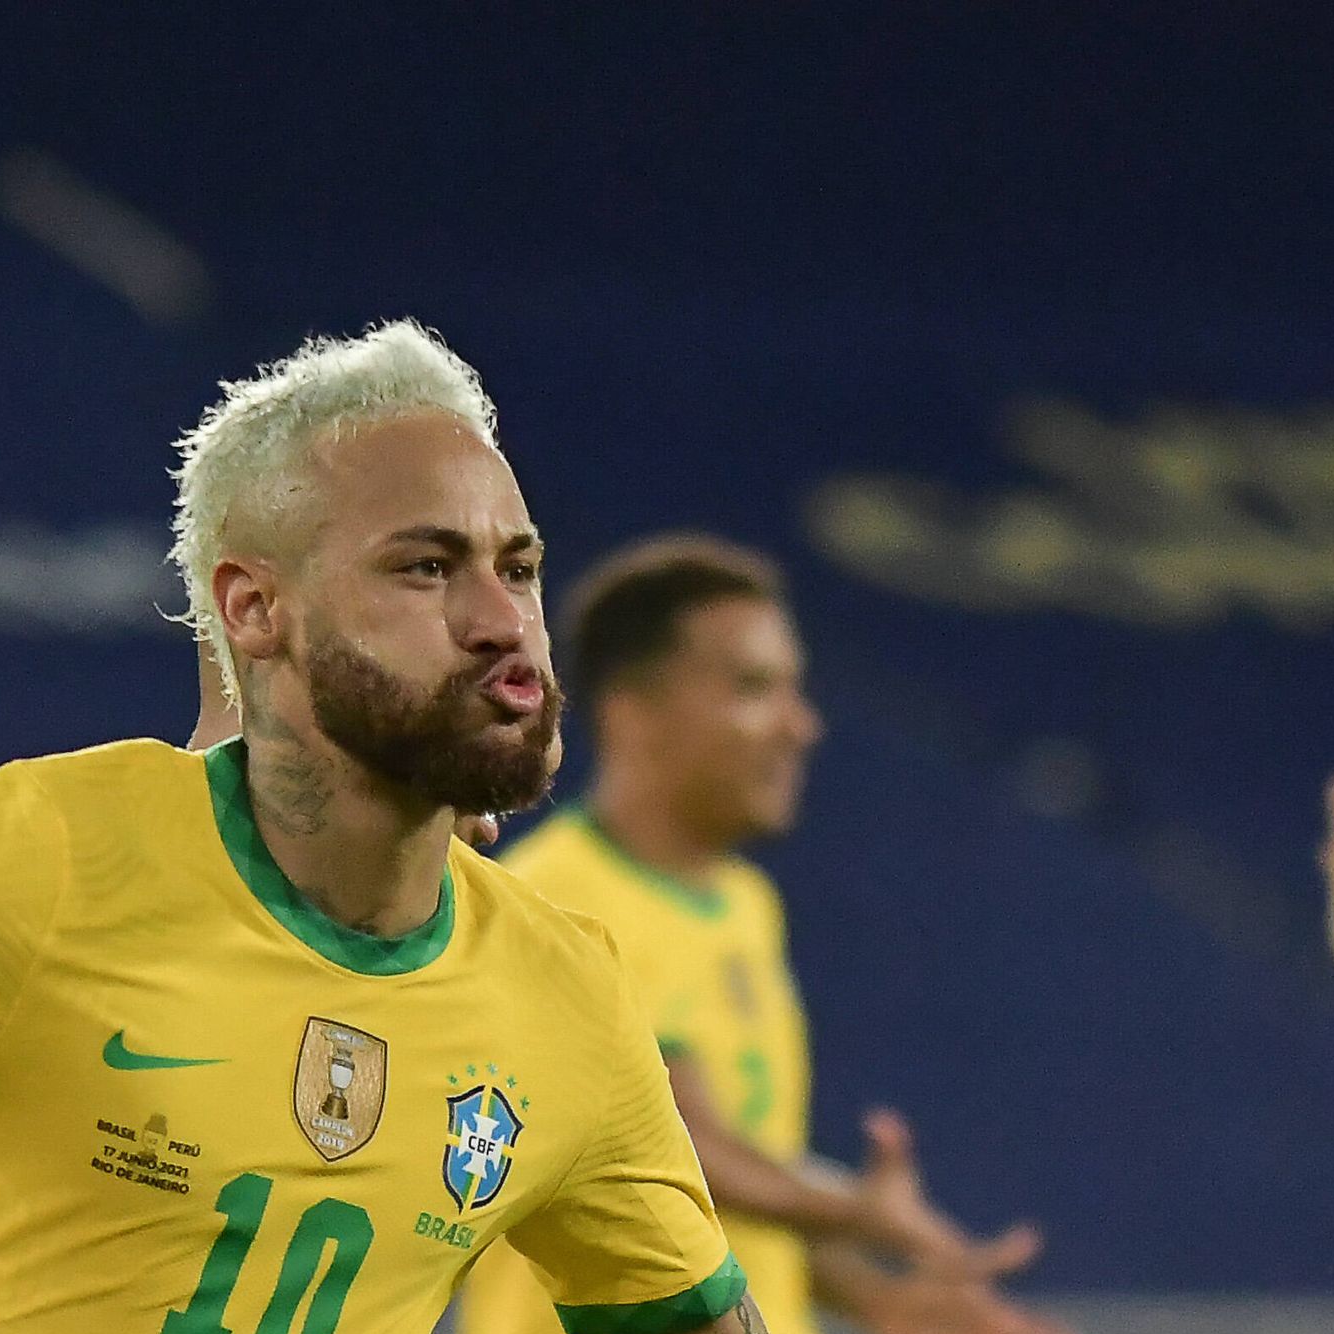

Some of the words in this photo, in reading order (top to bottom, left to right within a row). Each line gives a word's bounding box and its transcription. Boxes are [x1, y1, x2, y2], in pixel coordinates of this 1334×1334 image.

[97, 1120, 136, 1142] BRASIL
[168, 1140, 200, 1157] PERÚ
[468, 1135, 495, 1155] CBF
[91, 1157, 113, 1174] RIO
[116, 1167, 133, 1181] DE
[136, 1174, 189, 1194] JANEIRO
[104, 1145, 116, 1157] 17
[117, 1151, 157, 1169] JUNIO
[159, 1162, 188, 1178] 2021
[415, 1212, 475, 1249] BRASIL
